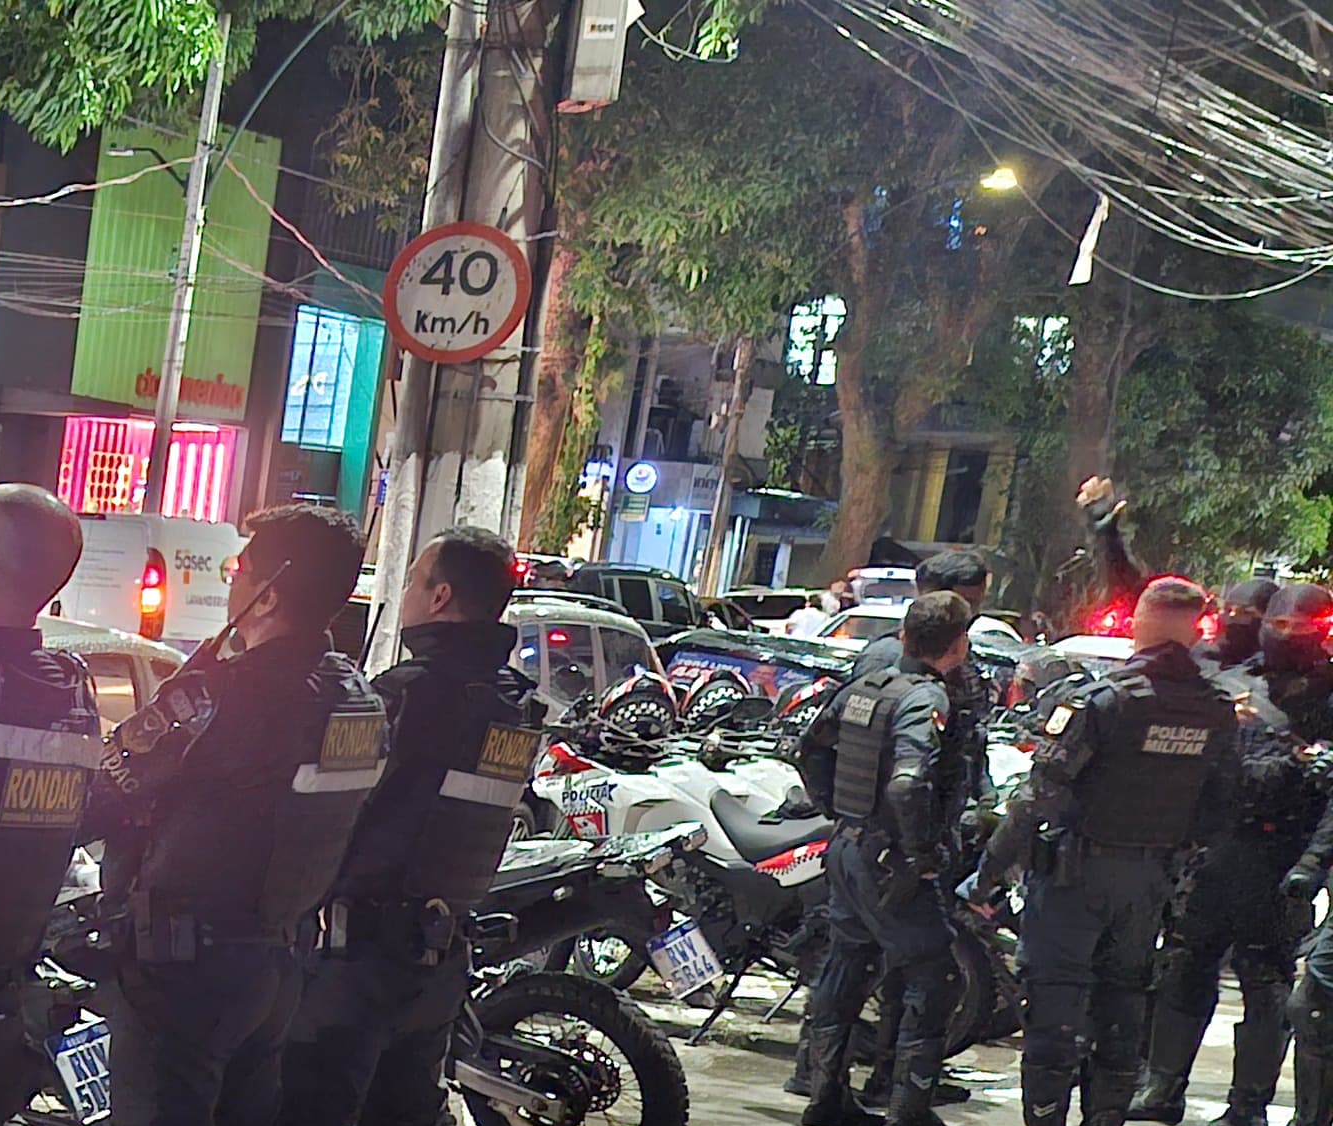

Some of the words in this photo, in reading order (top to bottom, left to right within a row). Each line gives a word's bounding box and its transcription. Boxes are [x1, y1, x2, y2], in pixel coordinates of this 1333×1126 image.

[419, 250, 498, 296] 40
[1142, 740, 1205, 755] MILITAR
[4, 768, 82, 810] RONDAC
